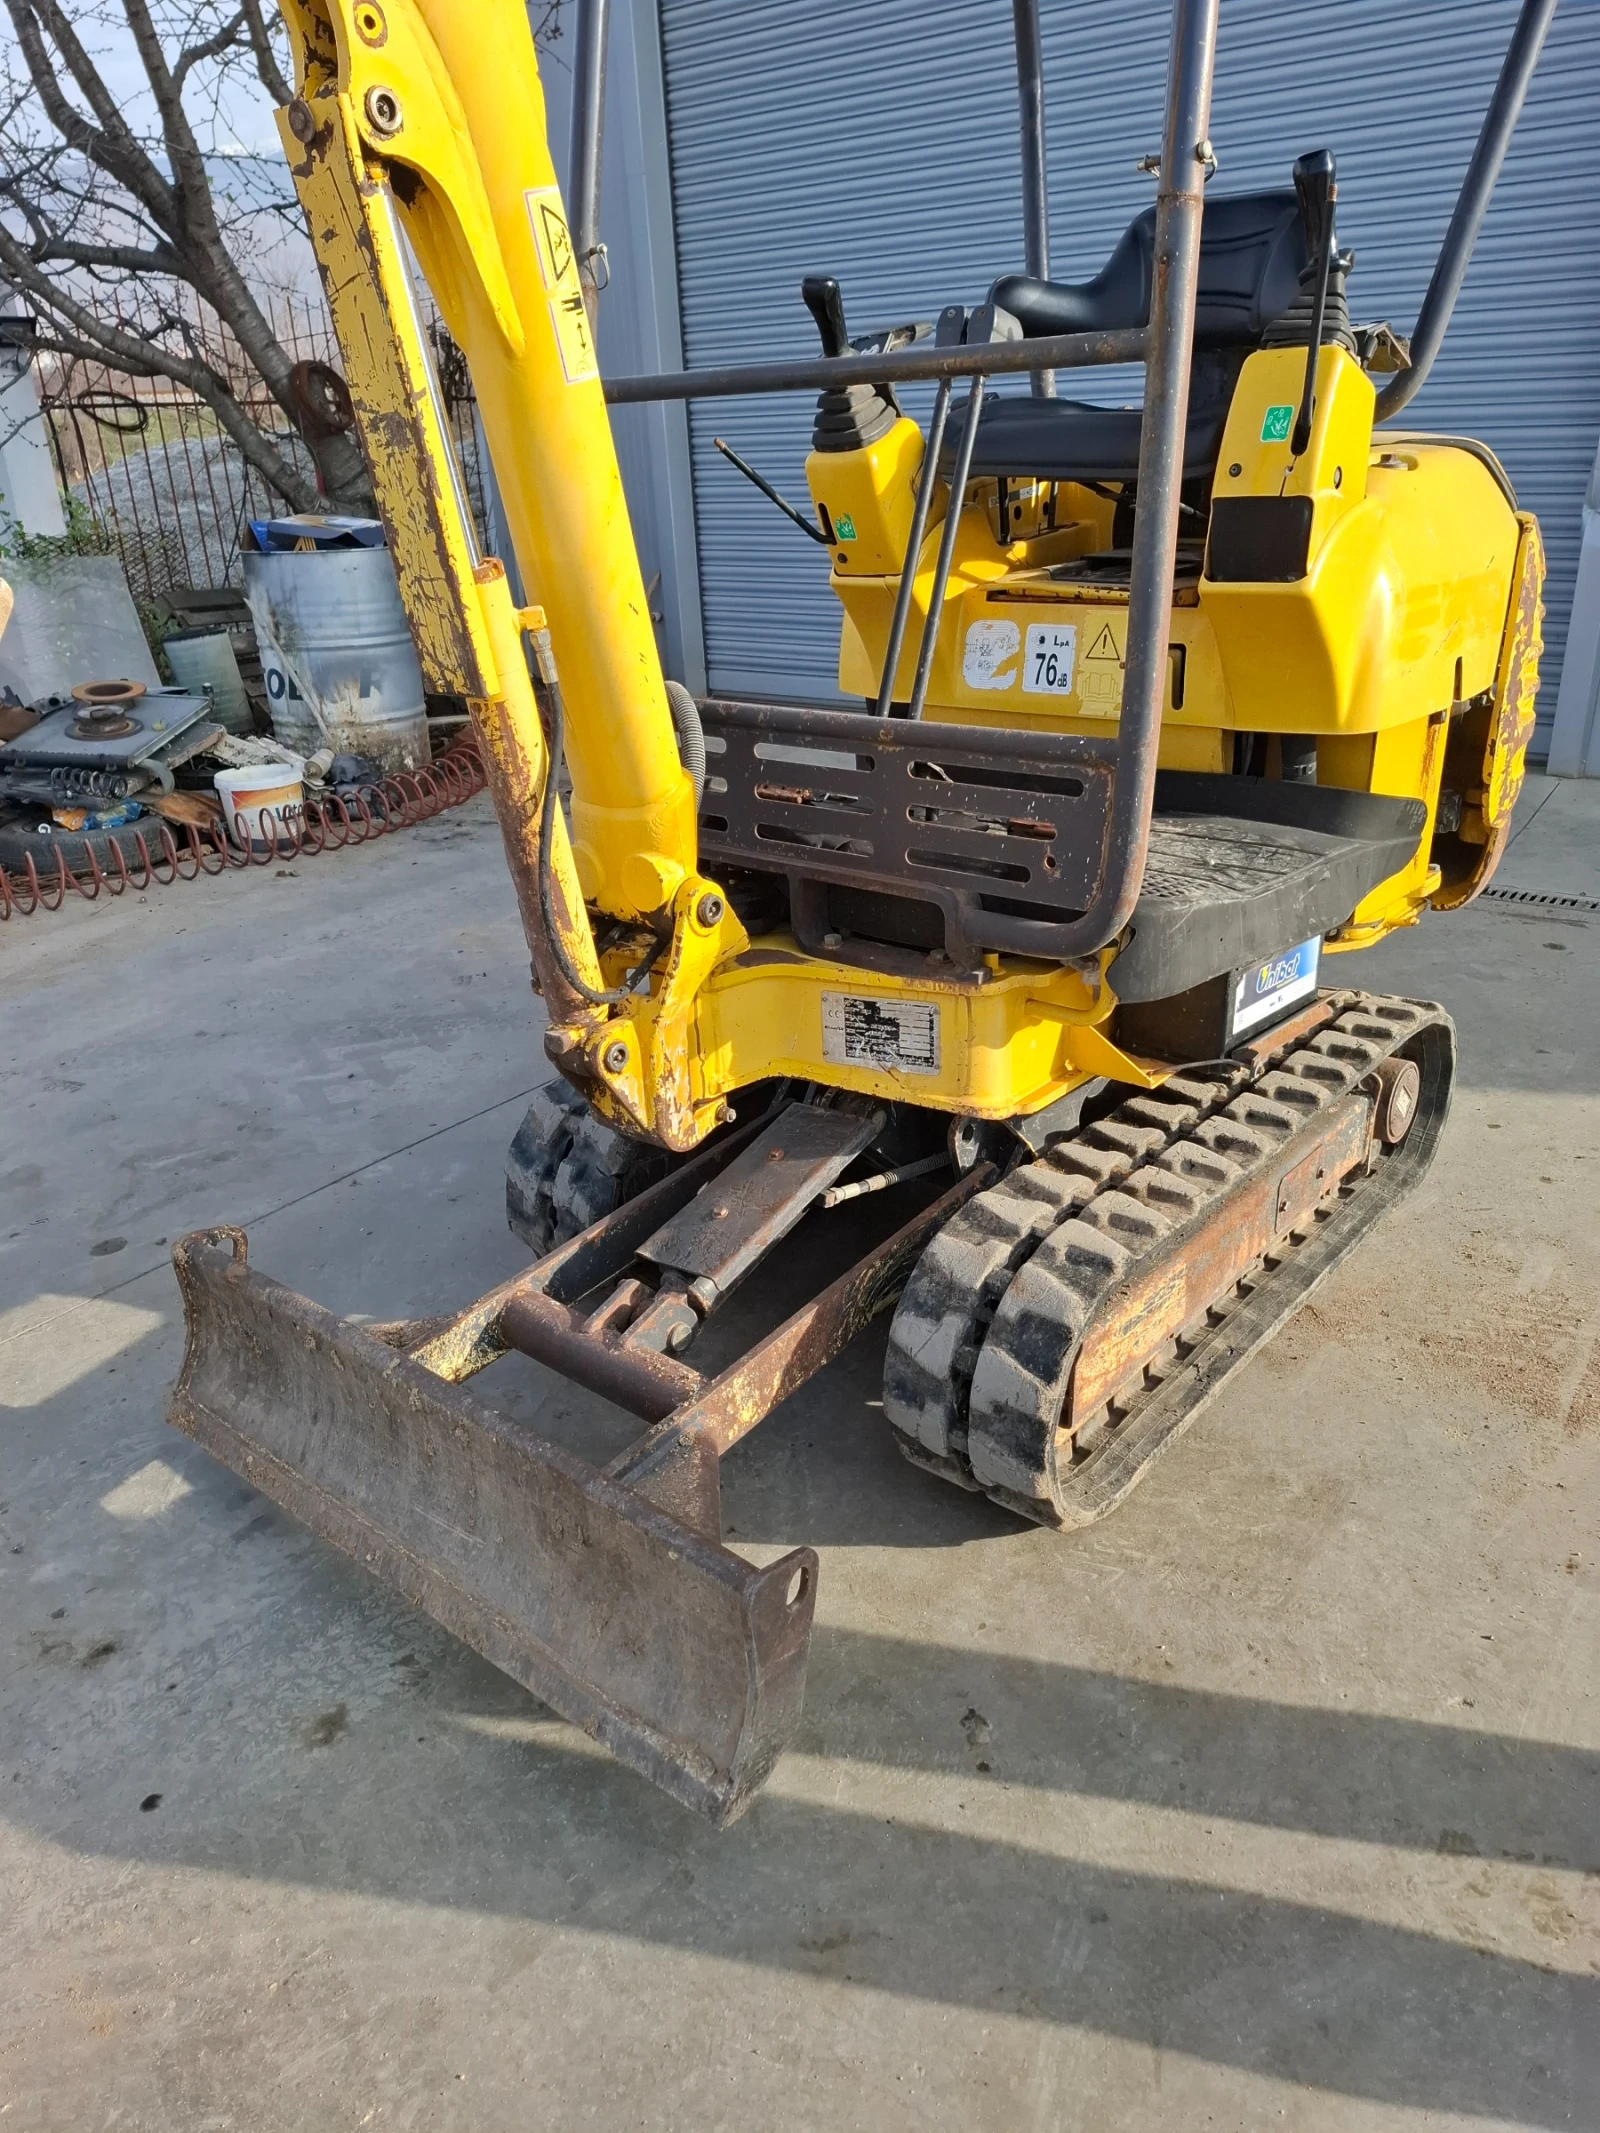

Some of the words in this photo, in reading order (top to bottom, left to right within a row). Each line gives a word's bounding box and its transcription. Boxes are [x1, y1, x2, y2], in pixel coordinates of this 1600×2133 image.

[1035, 653, 1058, 686] 76
[1057, 673, 1068, 688] dB
[1256, 951, 1301, 994] Unibat
